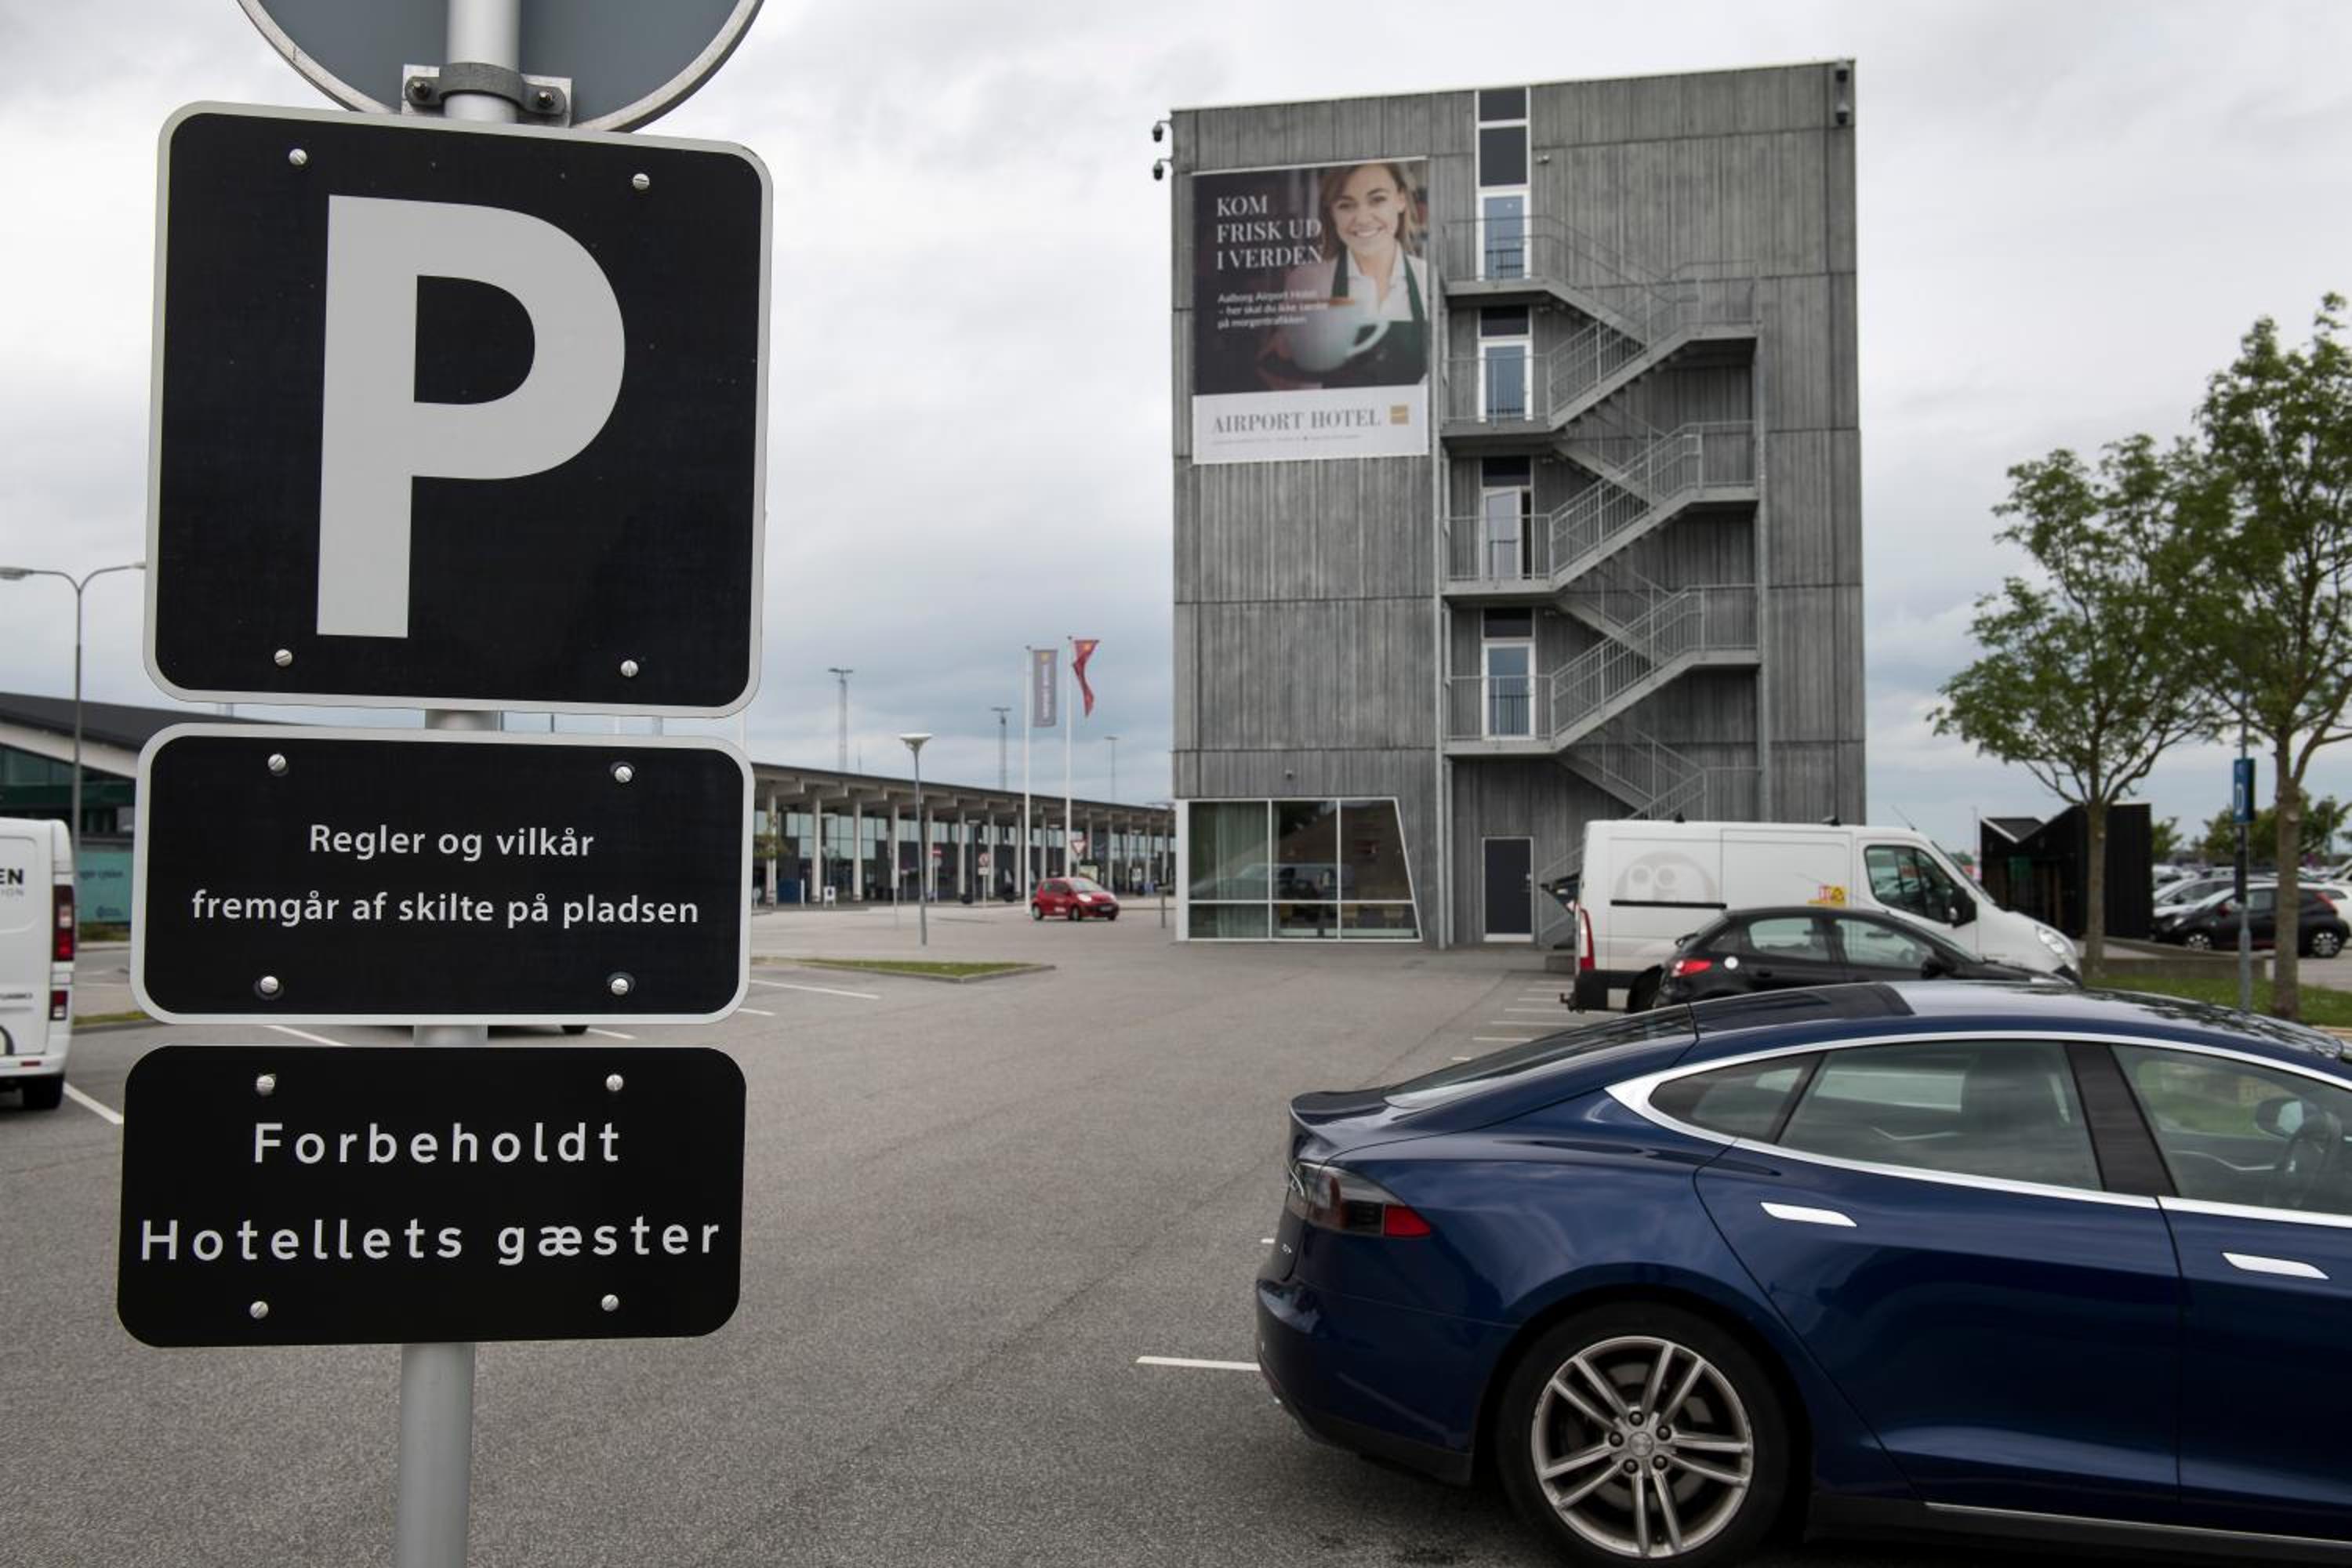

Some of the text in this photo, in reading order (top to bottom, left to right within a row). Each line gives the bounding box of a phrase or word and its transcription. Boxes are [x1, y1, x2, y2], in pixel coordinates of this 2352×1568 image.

[1217, 194, 1268, 216] KOM
[1217, 219, 1323, 243] FRISK UD
[1217, 245, 1323, 270] I VERDEN
[1255, 291, 1288, 302] Airport
[318, 195, 625, 638] P
[1213, 408, 1381, 434] AIRPORT HOTEL
[310, 824, 594, 862] Regler og vilkår
[191, 888, 698, 929] fremgår af skilte på pladsen
[255, 1122, 619, 1164] Forbeholdt
[142, 1215, 719, 1266] Hotellets gæster
